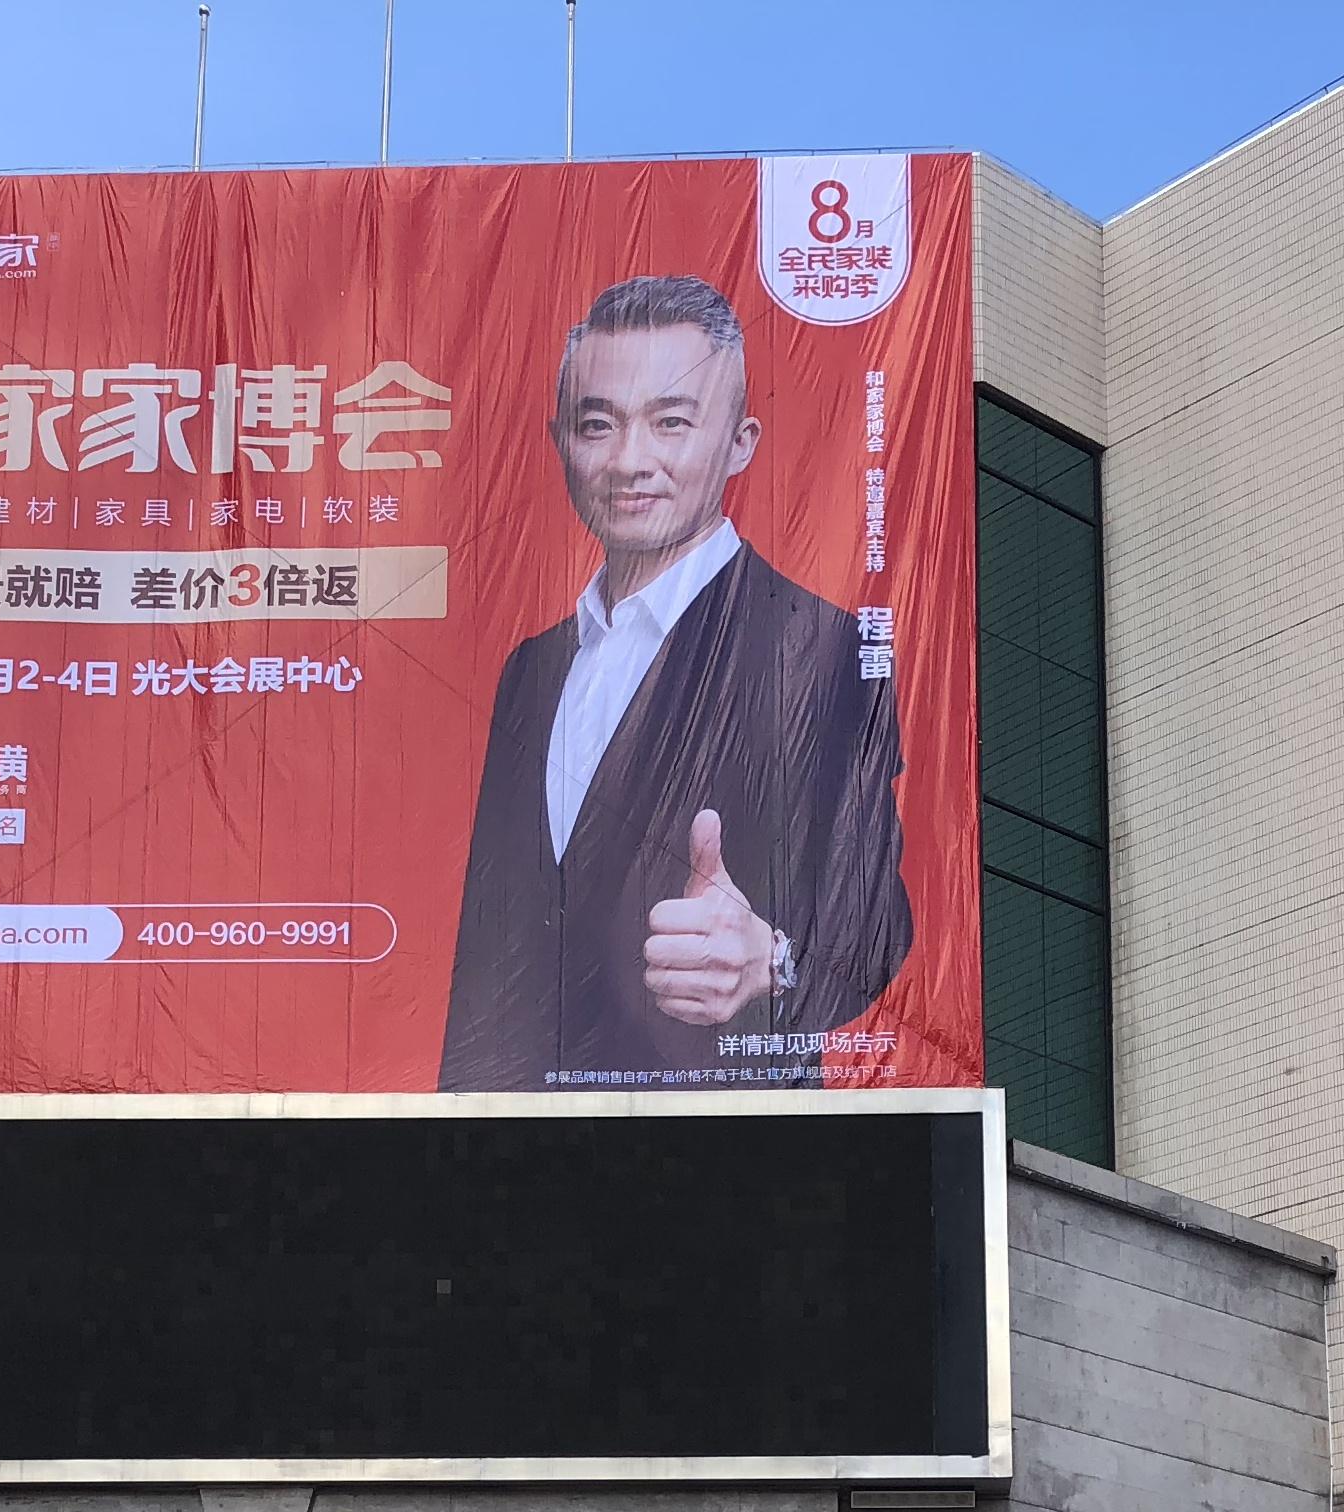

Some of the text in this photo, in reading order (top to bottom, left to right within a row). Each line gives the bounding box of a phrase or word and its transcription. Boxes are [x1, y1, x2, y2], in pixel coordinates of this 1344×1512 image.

[778, 246, 893, 272] 全民家装
[793, 275, 878, 299] 采购季
[865, 370, 885, 573] 和家家博会 特邀嘉宾主持
[130, 562, 359, 609] 差价3倍返
[857, 606, 894, 679] 程雷
[133, 655, 362, 696] 光大会展中心
[138, 921, 349, 947] 400-960-9991
[718, 1032, 897, 1057] 详情请见现场告示
